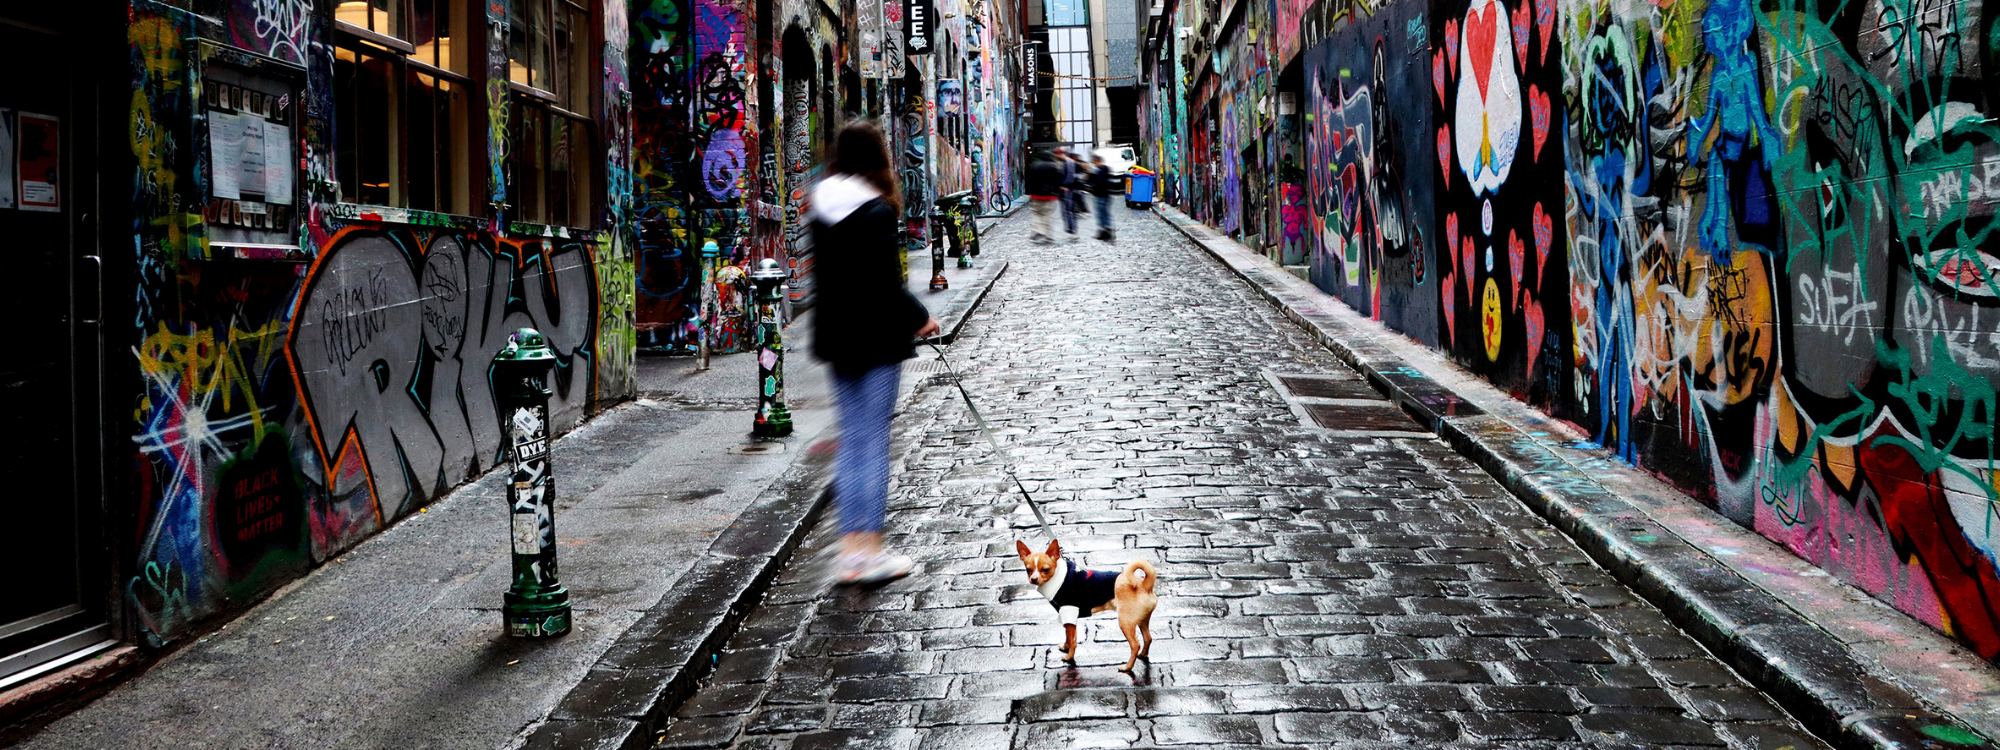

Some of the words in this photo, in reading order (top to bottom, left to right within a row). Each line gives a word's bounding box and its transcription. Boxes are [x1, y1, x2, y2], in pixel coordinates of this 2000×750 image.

[911, 0, 924, 36] EE
[1027, 48, 1035, 86] MASONS
[235, 467, 278, 500] BLACK
[237, 494, 273, 525] LIVES
[238, 512, 283, 542] MATTER
